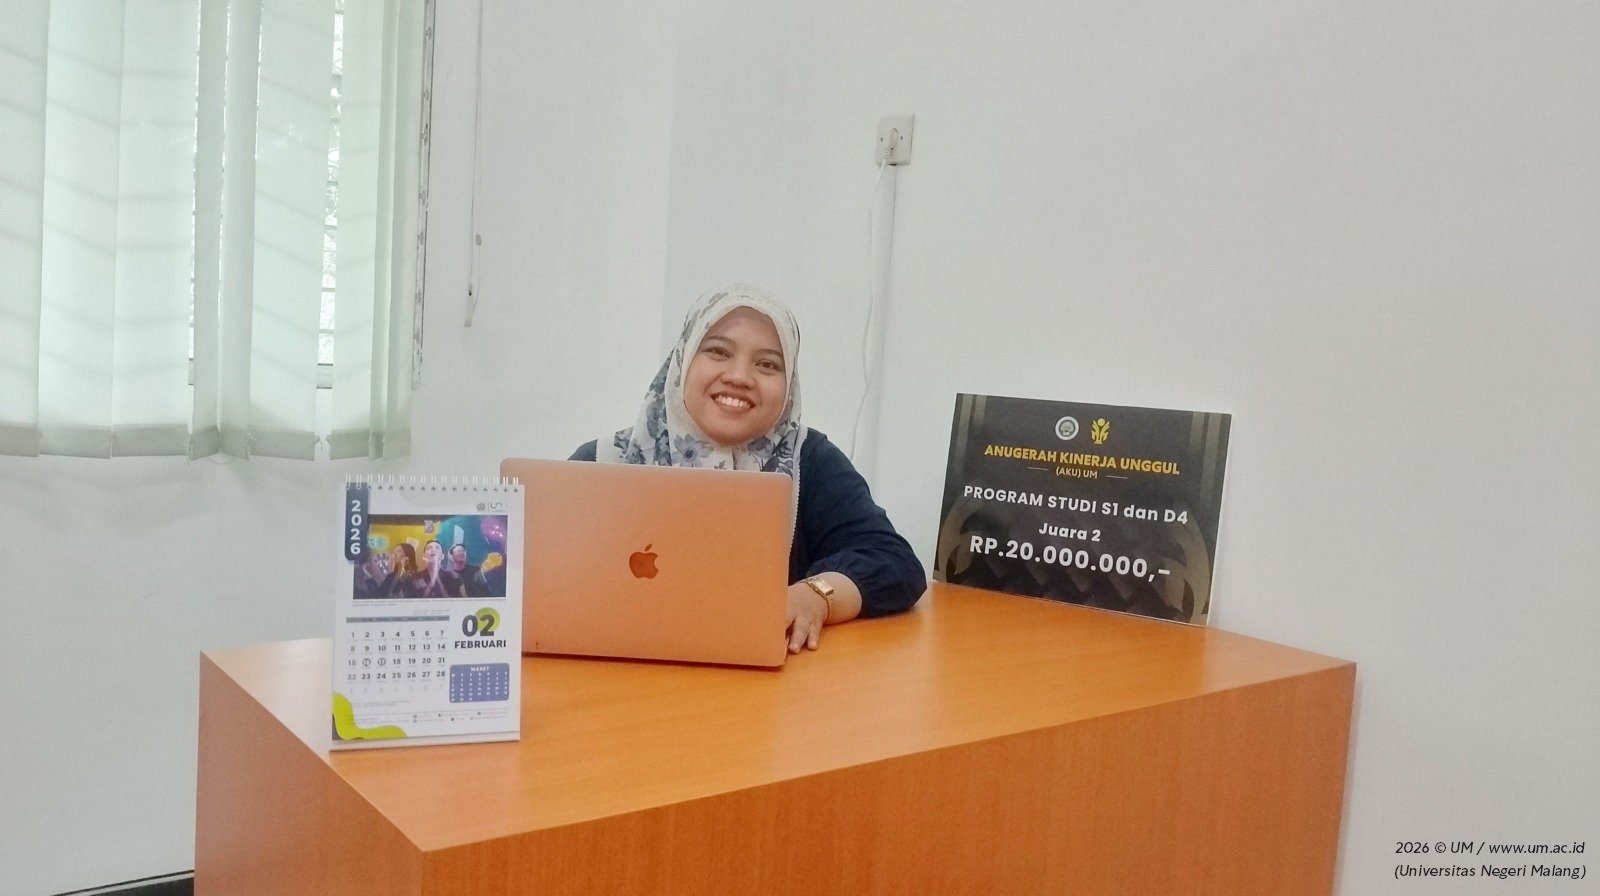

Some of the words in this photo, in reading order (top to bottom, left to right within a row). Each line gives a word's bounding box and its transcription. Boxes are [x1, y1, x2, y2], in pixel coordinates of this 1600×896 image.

[984, 444, 1057, 462] ANUGERAH
[1059, 452, 1117, 469] KINERJA
[1120, 458, 1180, 475] UNGGUL
[1056, 467, 1081, 478] (AKU)
[1083, 469, 1098, 479] UM
[963, 485, 1043, 507] PROGRAM
[1048, 495, 1097, 513] STUDI
[1101, 502, 1118, 516] S1
[1124, 504, 1158, 521] dan
[1164, 509, 1188, 524] D4
[350, 500, 362, 555] 2026
[1038, 523, 1087, 540] Juara
[1091, 529, 1101, 542] 2
[969, 535, 1171, 583] RP.20.000.000,-
[462, 614, 495, 637] 02
[455, 640, 506, 649] FEBRUARI
